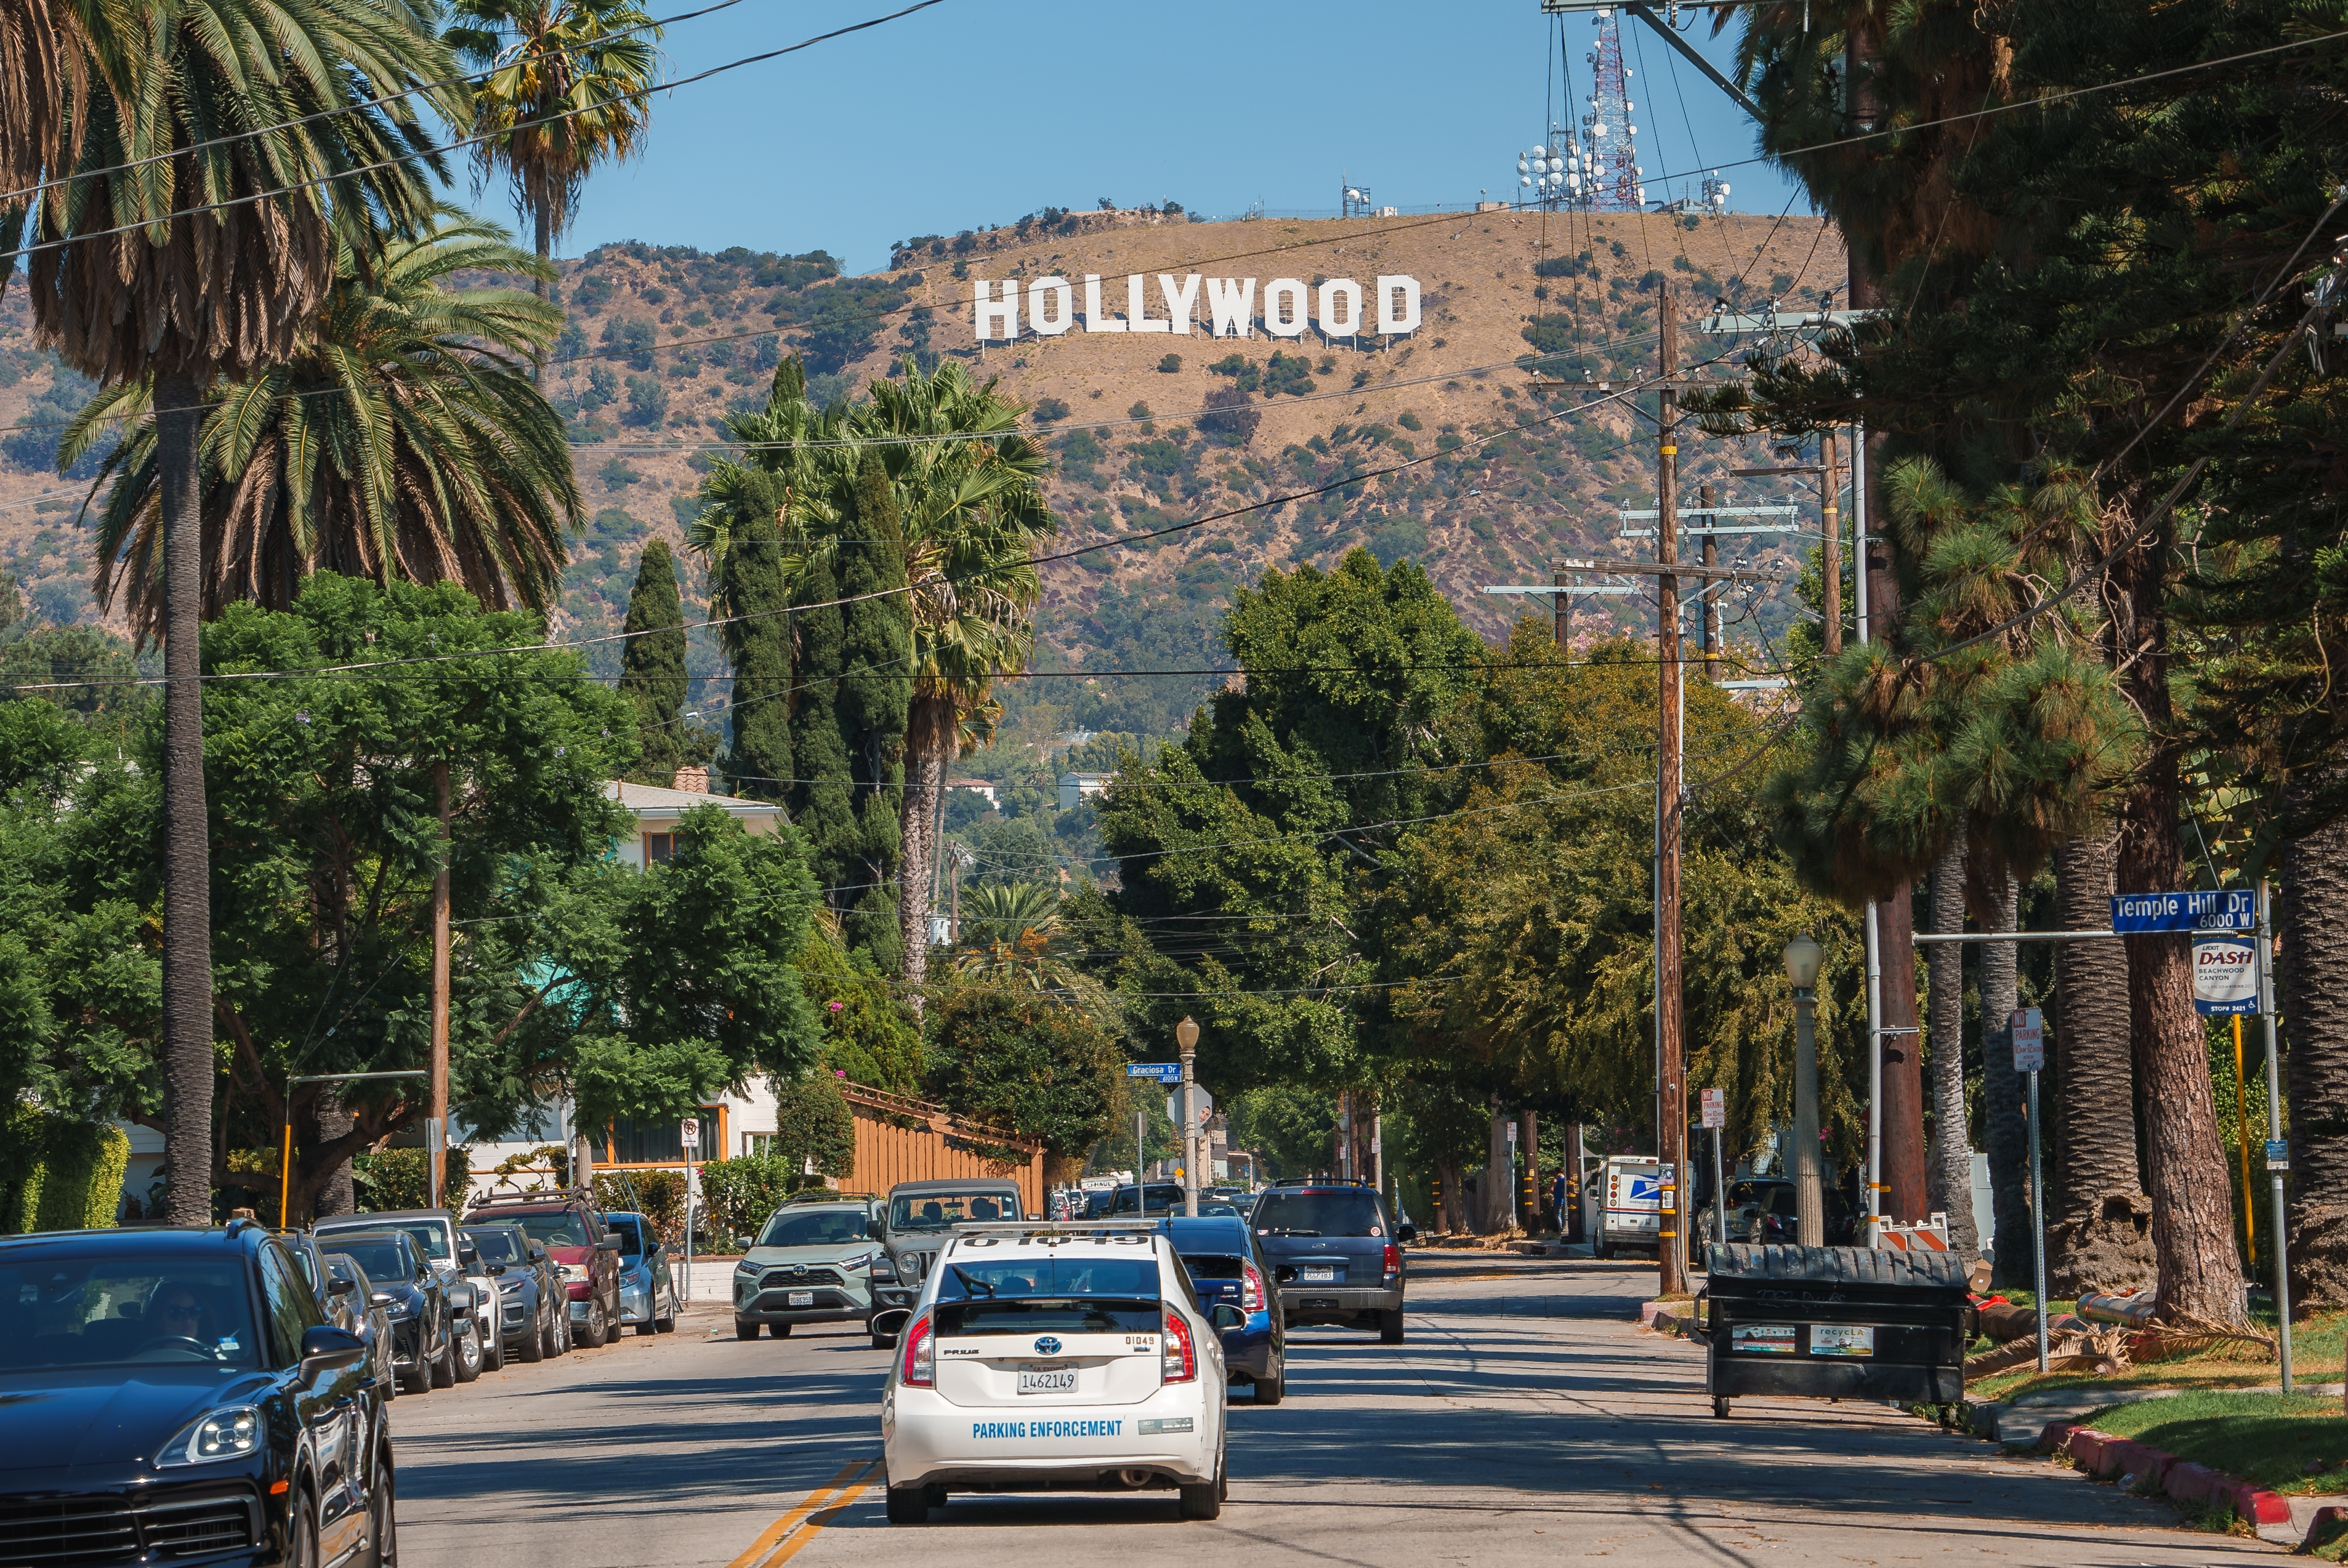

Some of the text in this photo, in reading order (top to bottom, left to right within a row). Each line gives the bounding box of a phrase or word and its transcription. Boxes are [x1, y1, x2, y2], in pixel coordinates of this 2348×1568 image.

[974, 273, 1421, 340] HOLLYWOOD
[2115, 893, 2249, 920] Temple Hill Dr
[2200, 913, 2250, 928] 6000 W
[2199, 951, 2253, 965] DASH
[2014, 1012, 2025, 1026] NO
[2015, 1028, 2039, 1041] PARKING
[1132, 1066, 1176, 1074] Graciosa Dr
[1703, 1092, 1710, 1100] NO
[964, 1236, 1148, 1247] 01049
[1820, 1327, 1864, 1337] recycLA
[1126, 1337, 1154, 1345] 01049
[1022, 1374, 1075, 1388] 1462149
[973, 1422, 1025, 1438] PARKING
[1030, 1420, 1123, 1437] ENFORCEMENT
